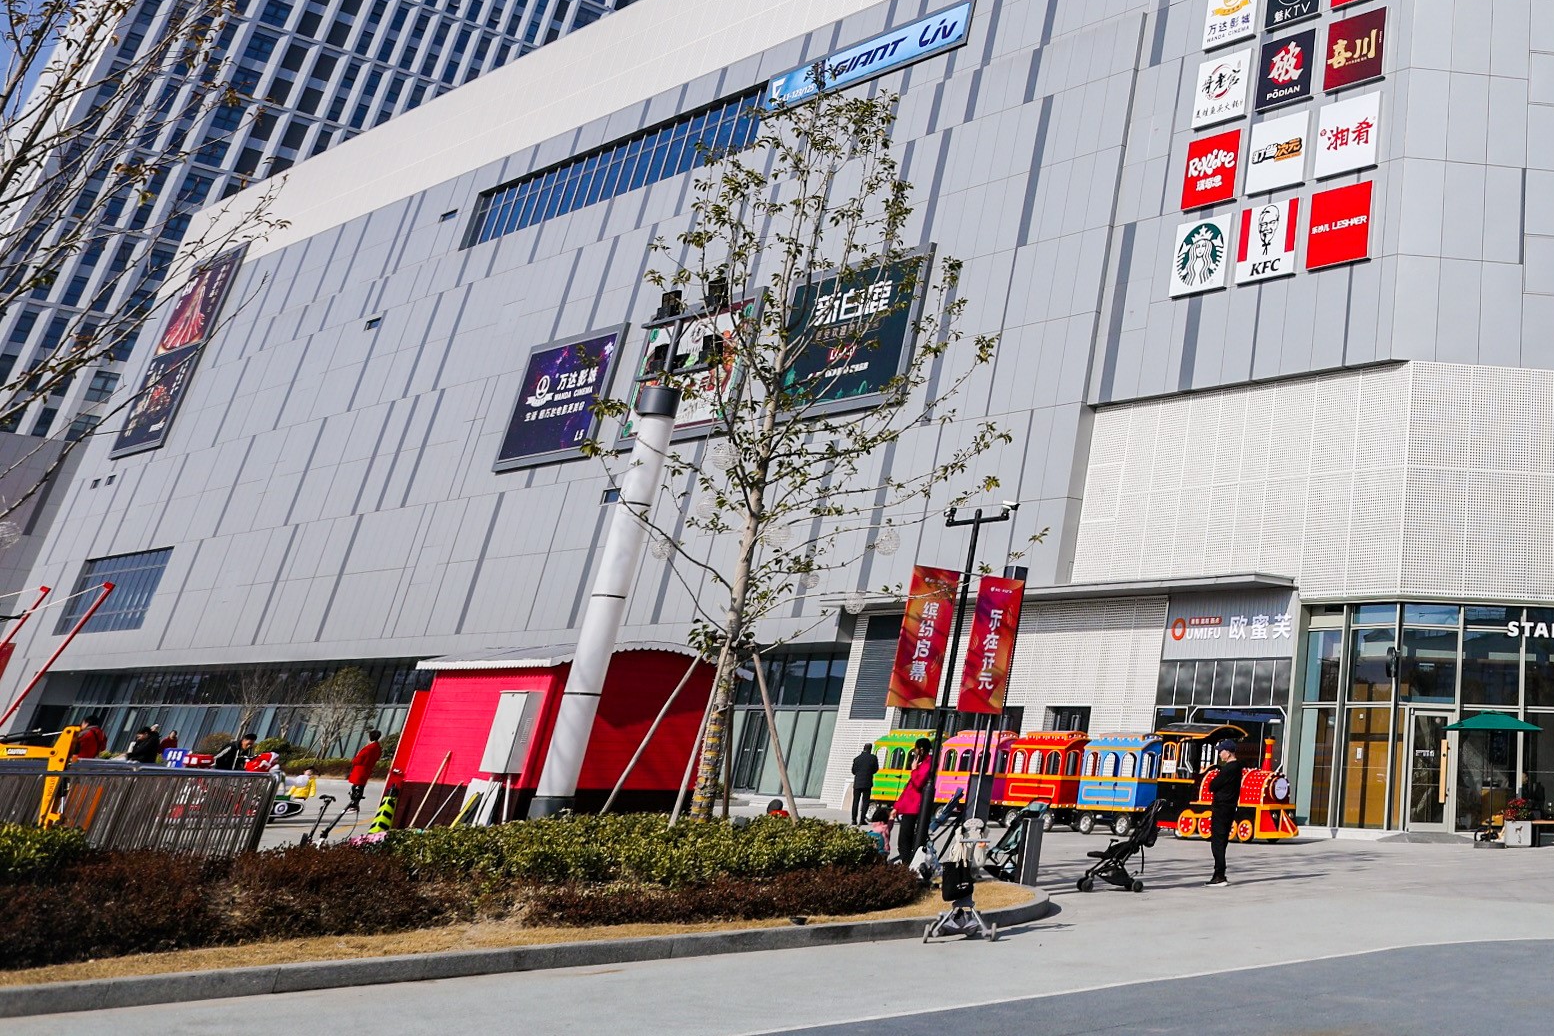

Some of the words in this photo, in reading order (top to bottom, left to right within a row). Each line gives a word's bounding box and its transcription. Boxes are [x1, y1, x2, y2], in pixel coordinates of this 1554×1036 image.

[1206, 33, 1226, 43] WANDA
[1228, 25, 1250, 36] CINEMA
[1207, 12, 1251, 36] 万达影城
[835, 35, 908, 77] GIANT
[918, 18, 958, 48] Liv
[1267, 40, 1304, 83] 破
[1327, 28, 1378, 69] 喜川
[1326, 116, 1374, 151] 湘肴
[1249, 257, 1281, 277] KFC
[556, 366, 599, 391] 万达影城
[553, 390, 572, 402] WANDA
[573, 385, 594, 397] CINEMA
[1171, 617, 1221, 641] OUMIFU
[1228, 613, 1293, 641] 欧蜜芙
[909, 601, 940, 683] 缤纷启幕
[977, 609, 1004, 690] 乐在开元
